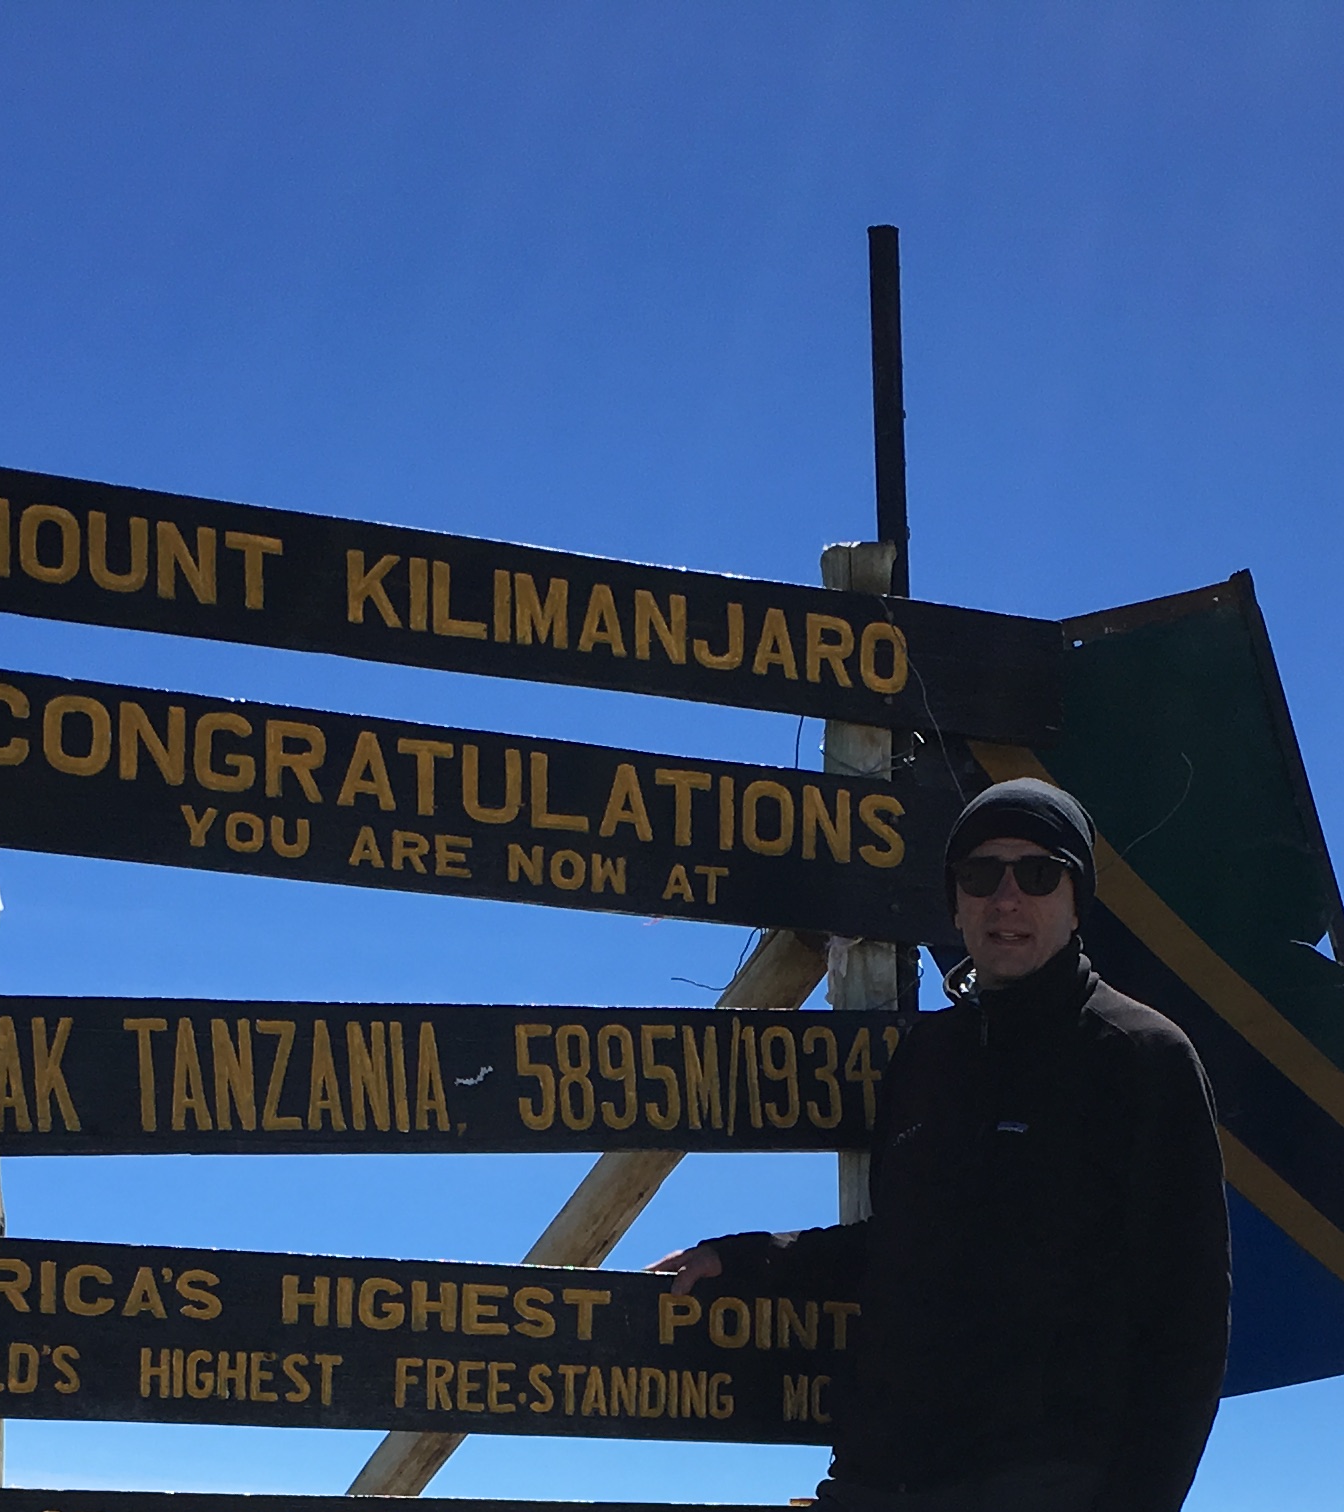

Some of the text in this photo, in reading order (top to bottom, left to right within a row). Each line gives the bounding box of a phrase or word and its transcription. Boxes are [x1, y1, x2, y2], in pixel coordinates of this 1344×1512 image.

[346, 549, 908, 694] KILIMANJARO
[180, 804, 729, 904] YOU ARE NOW AT
[281, 1274, 611, 1341] HIGHEST
[658, 1292, 861, 1350] POINT
[139, 1347, 343, 1406] HIGHEST
